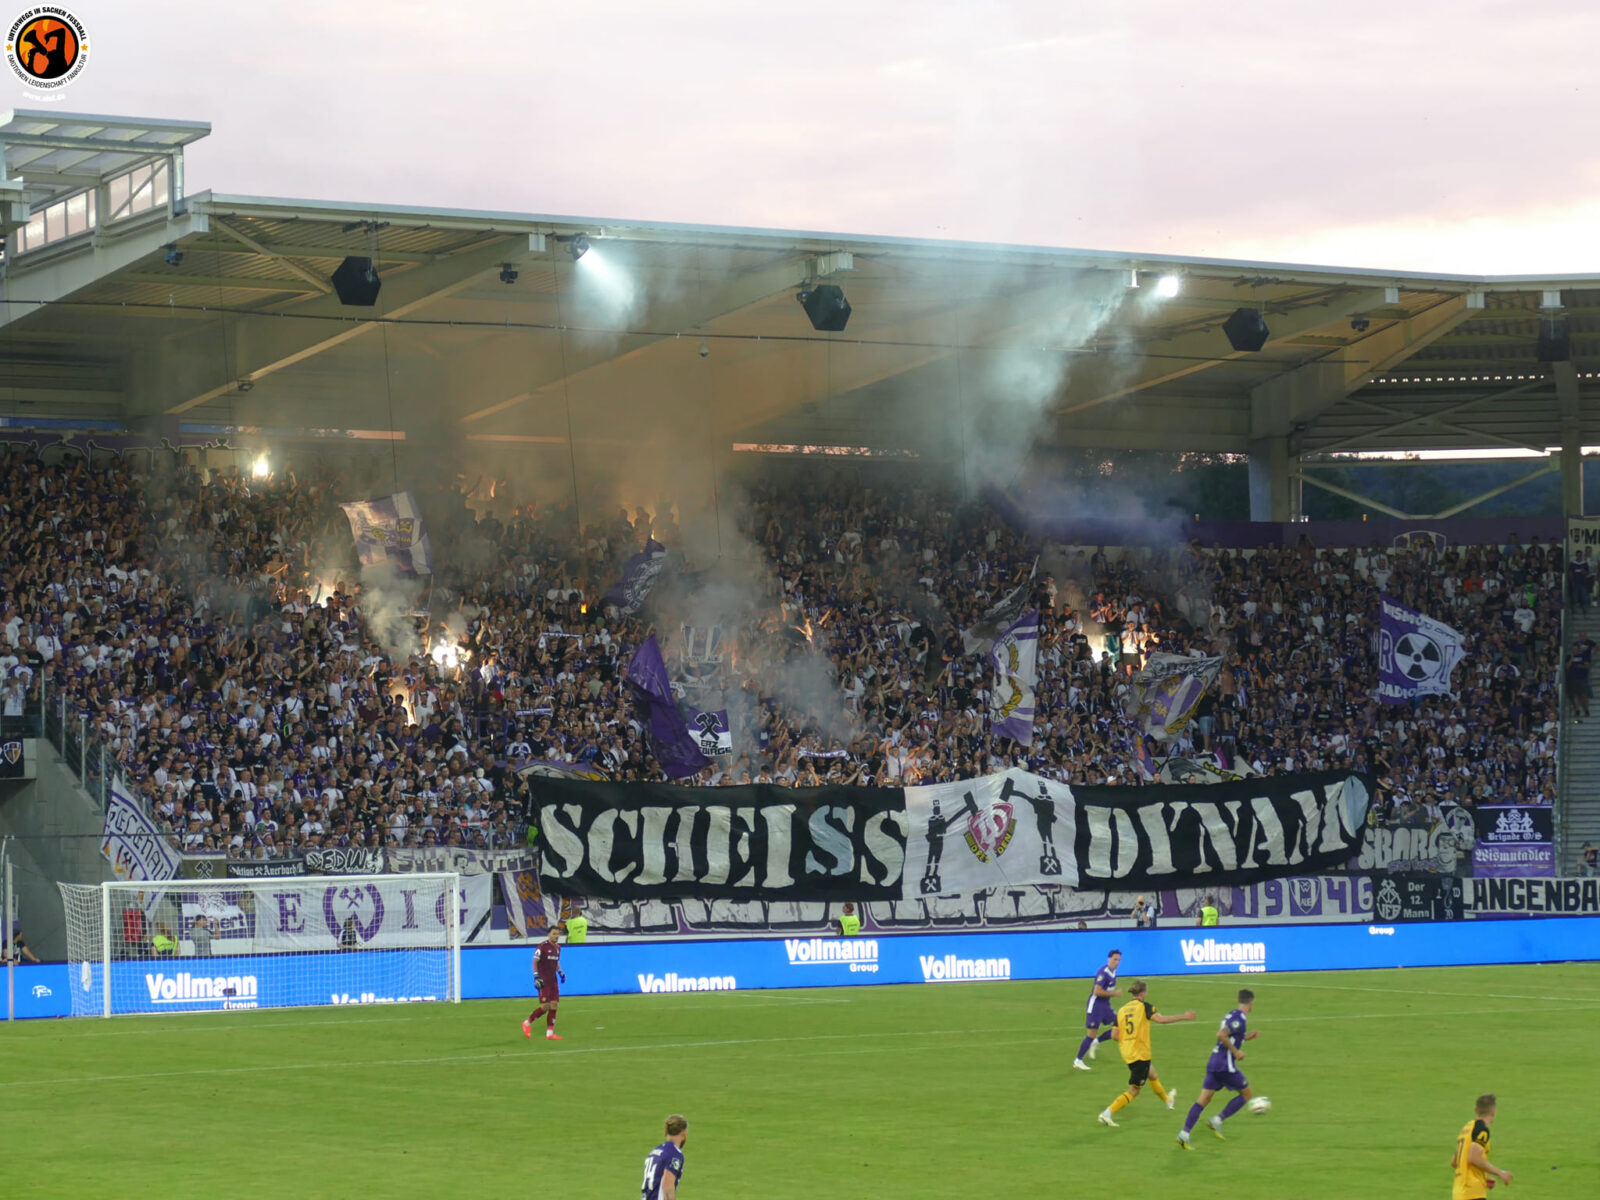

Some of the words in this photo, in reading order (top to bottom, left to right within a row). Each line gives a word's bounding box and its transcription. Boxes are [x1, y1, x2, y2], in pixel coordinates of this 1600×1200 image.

[698, 747, 731, 755] BIRGE
[701, 739, 719, 748] ERZ
[540, 803, 909, 888] SCHEISS
[1475, 848, 1552, 863] Wismutadler
[1408, 882, 1425, 892] Der
[1410, 895, 1423, 905] 12.
[1461, 878, 1600, 912] LANGENBA
[1403, 909, 1430, 919] Mann
[1368, 926, 1395, 936] Group
[785, 939, 879, 961] Vollmann
[1181, 939, 1265, 961] Vollmann
[850, 964, 879, 973] Group
[920, 955, 1010, 979] Vollmann
[1239, 965, 1266, 973] Group
[145, 972, 258, 1000] Vollmann
[637, 972, 736, 993] Vollmann
[1125, 1014, 1135, 1036] 5
